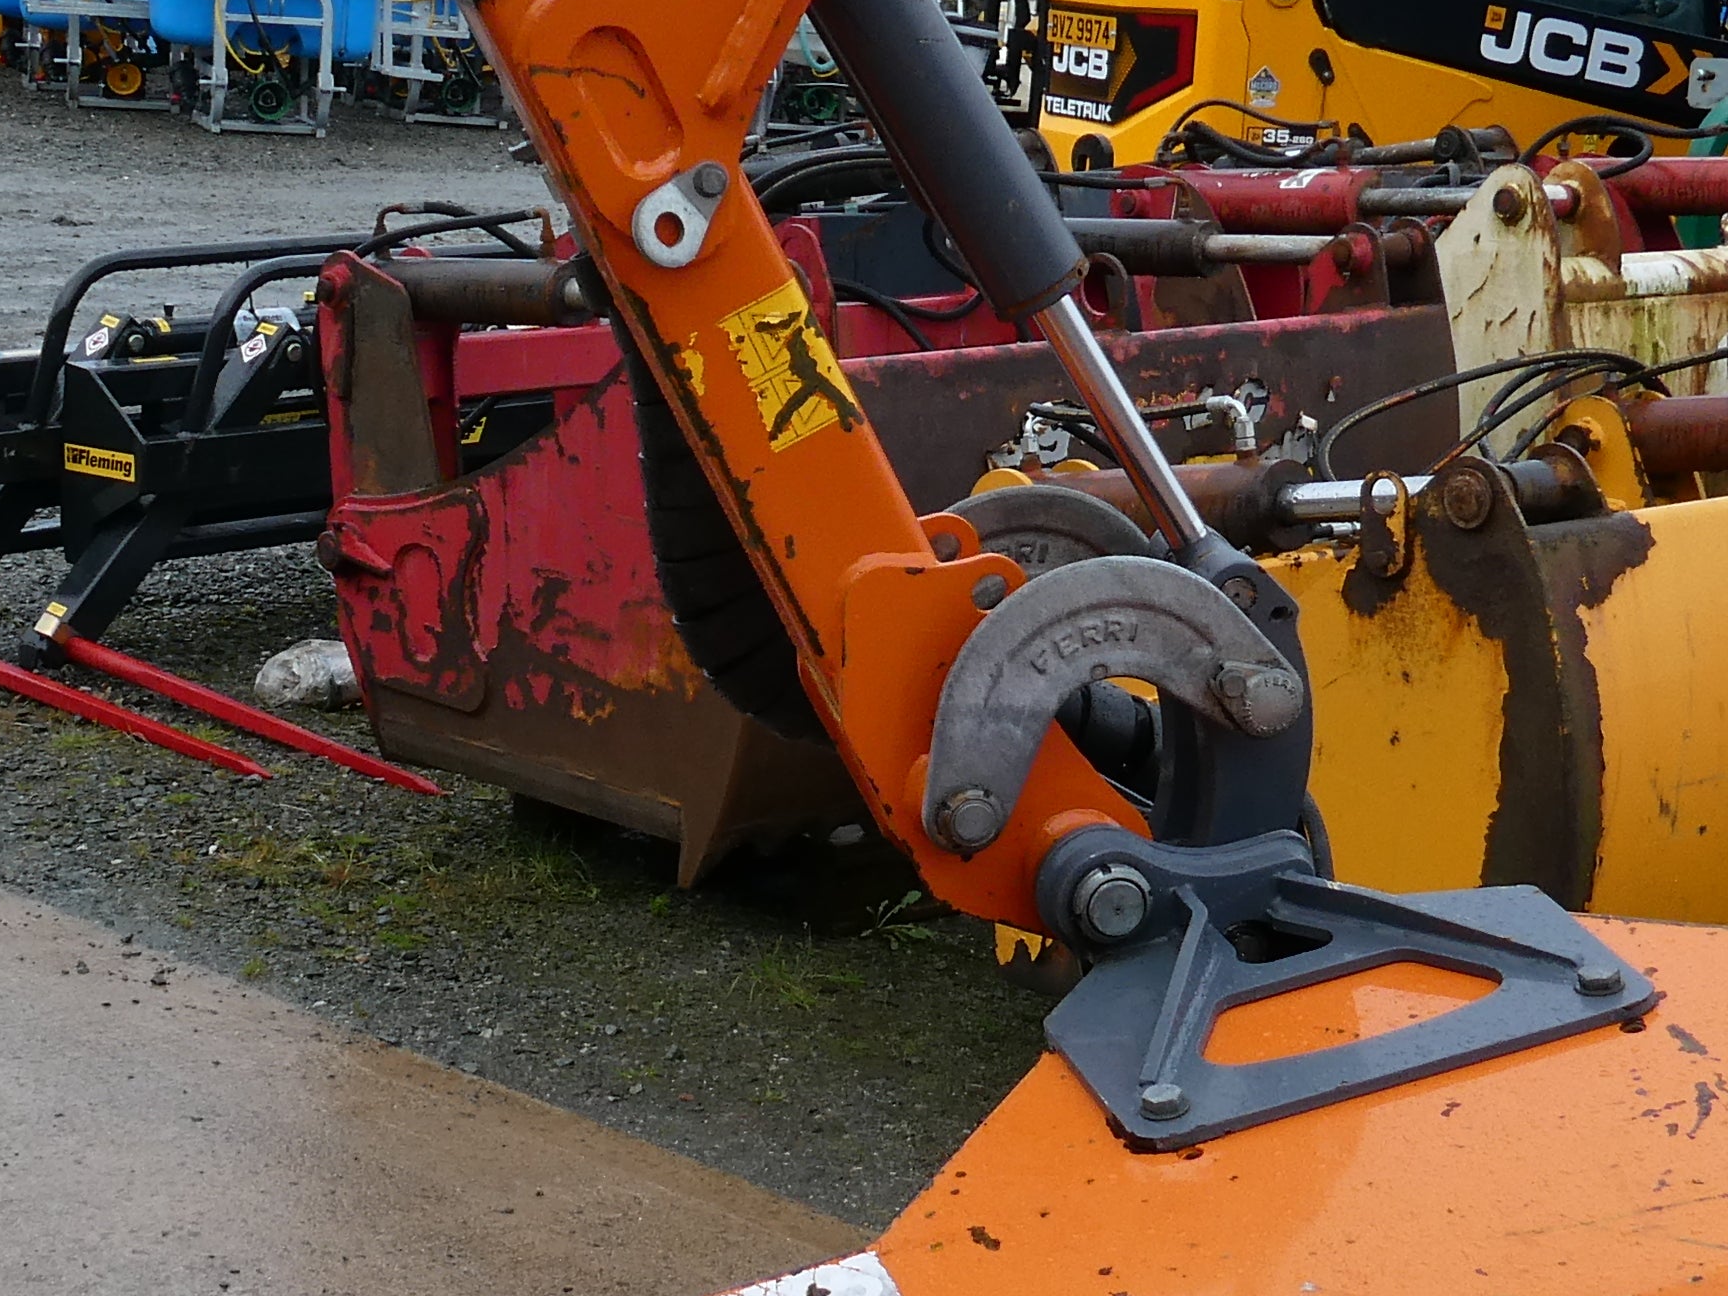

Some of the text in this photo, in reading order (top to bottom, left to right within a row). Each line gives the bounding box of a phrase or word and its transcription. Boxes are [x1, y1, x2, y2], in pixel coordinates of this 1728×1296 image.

[1052, 14, 1110, 45] BVZ 9974
[1052, 44, 1109, 80] JCB
[1480, 11, 1644, 88] JCB
[1046, 95, 1112, 122] TELETRUK
[79, 450, 133, 477] Fleming
[1030, 619, 1139, 675] FERRI
